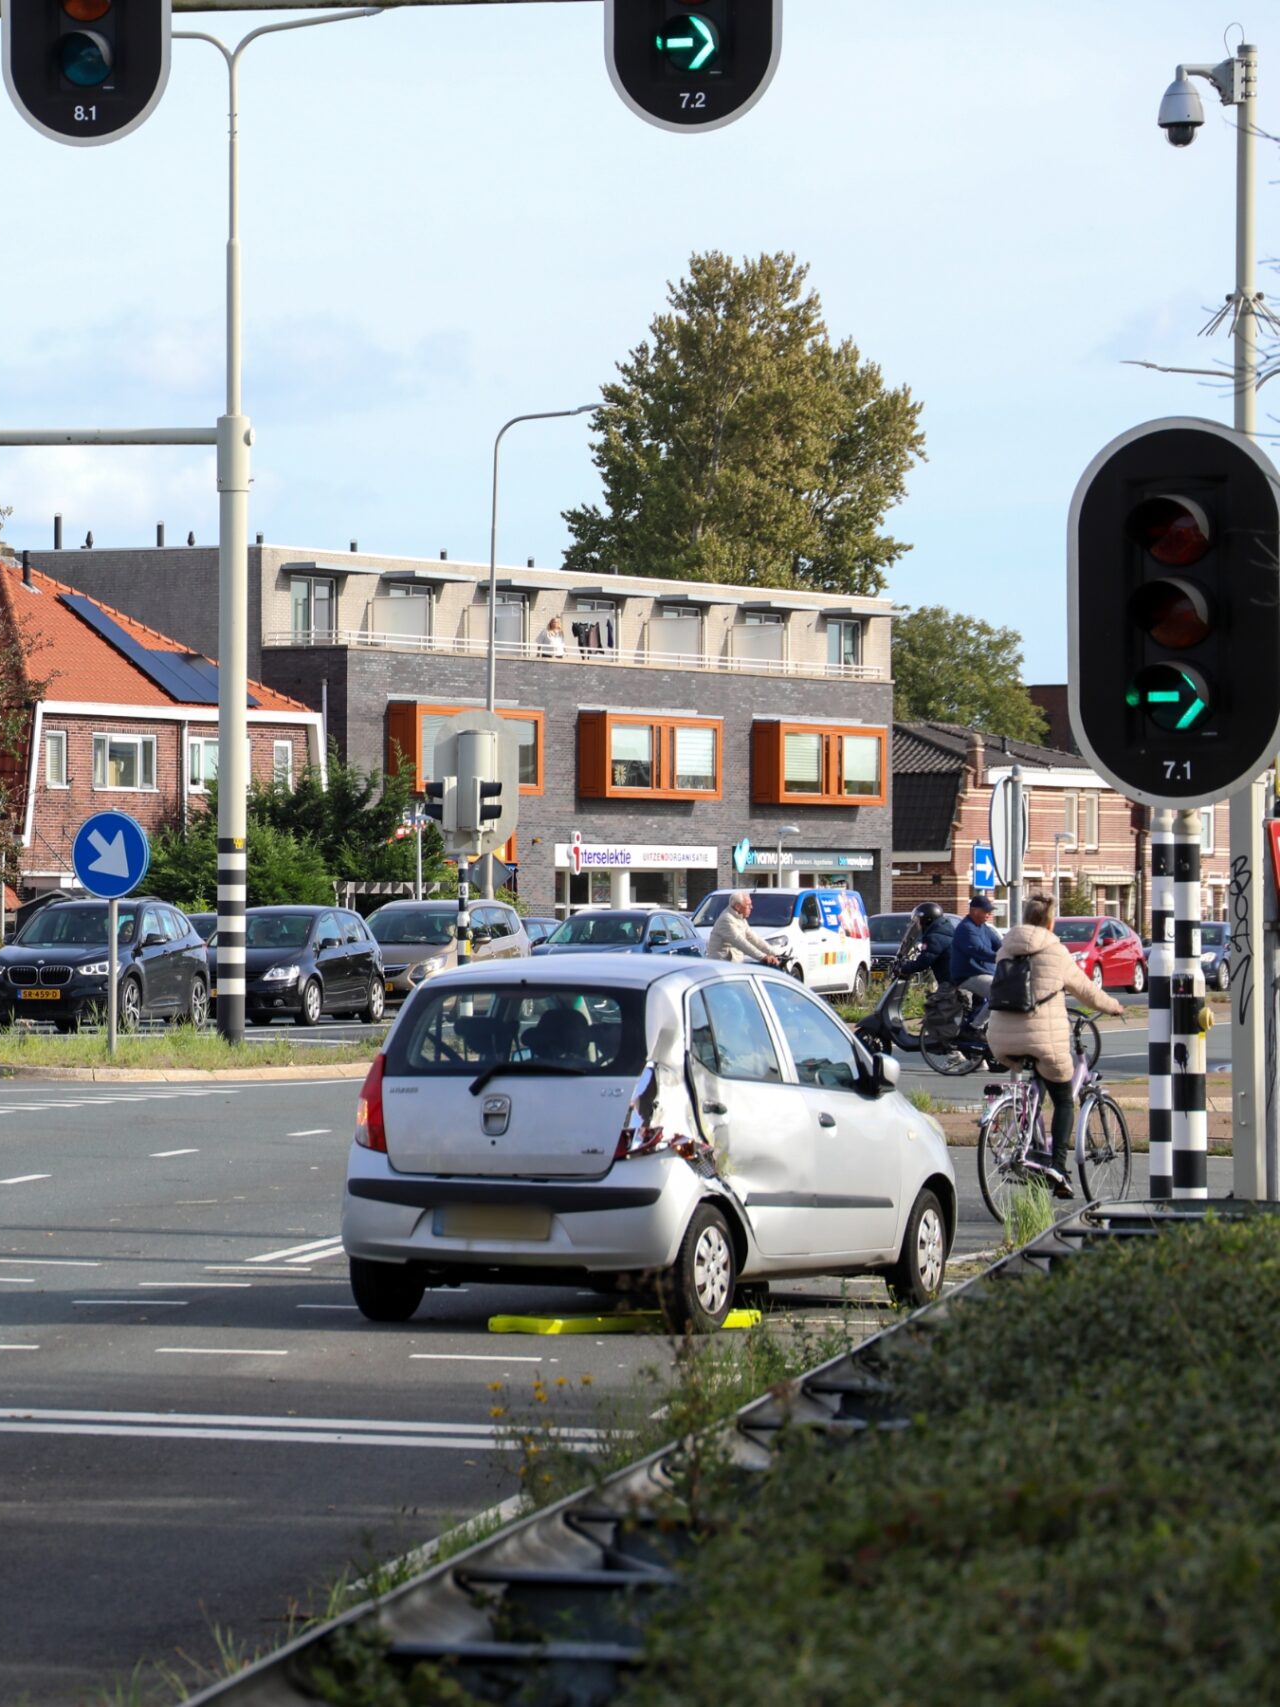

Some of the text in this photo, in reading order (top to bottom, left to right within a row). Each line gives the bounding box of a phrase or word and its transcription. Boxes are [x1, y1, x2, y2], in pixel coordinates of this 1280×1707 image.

[679, 92, 706, 109] 7.2
[73, 105, 97, 121] 8.1
[1163, 760, 1191, 780] 7.1
[642, 853, 709, 862] UITZENDORGANISATIE
